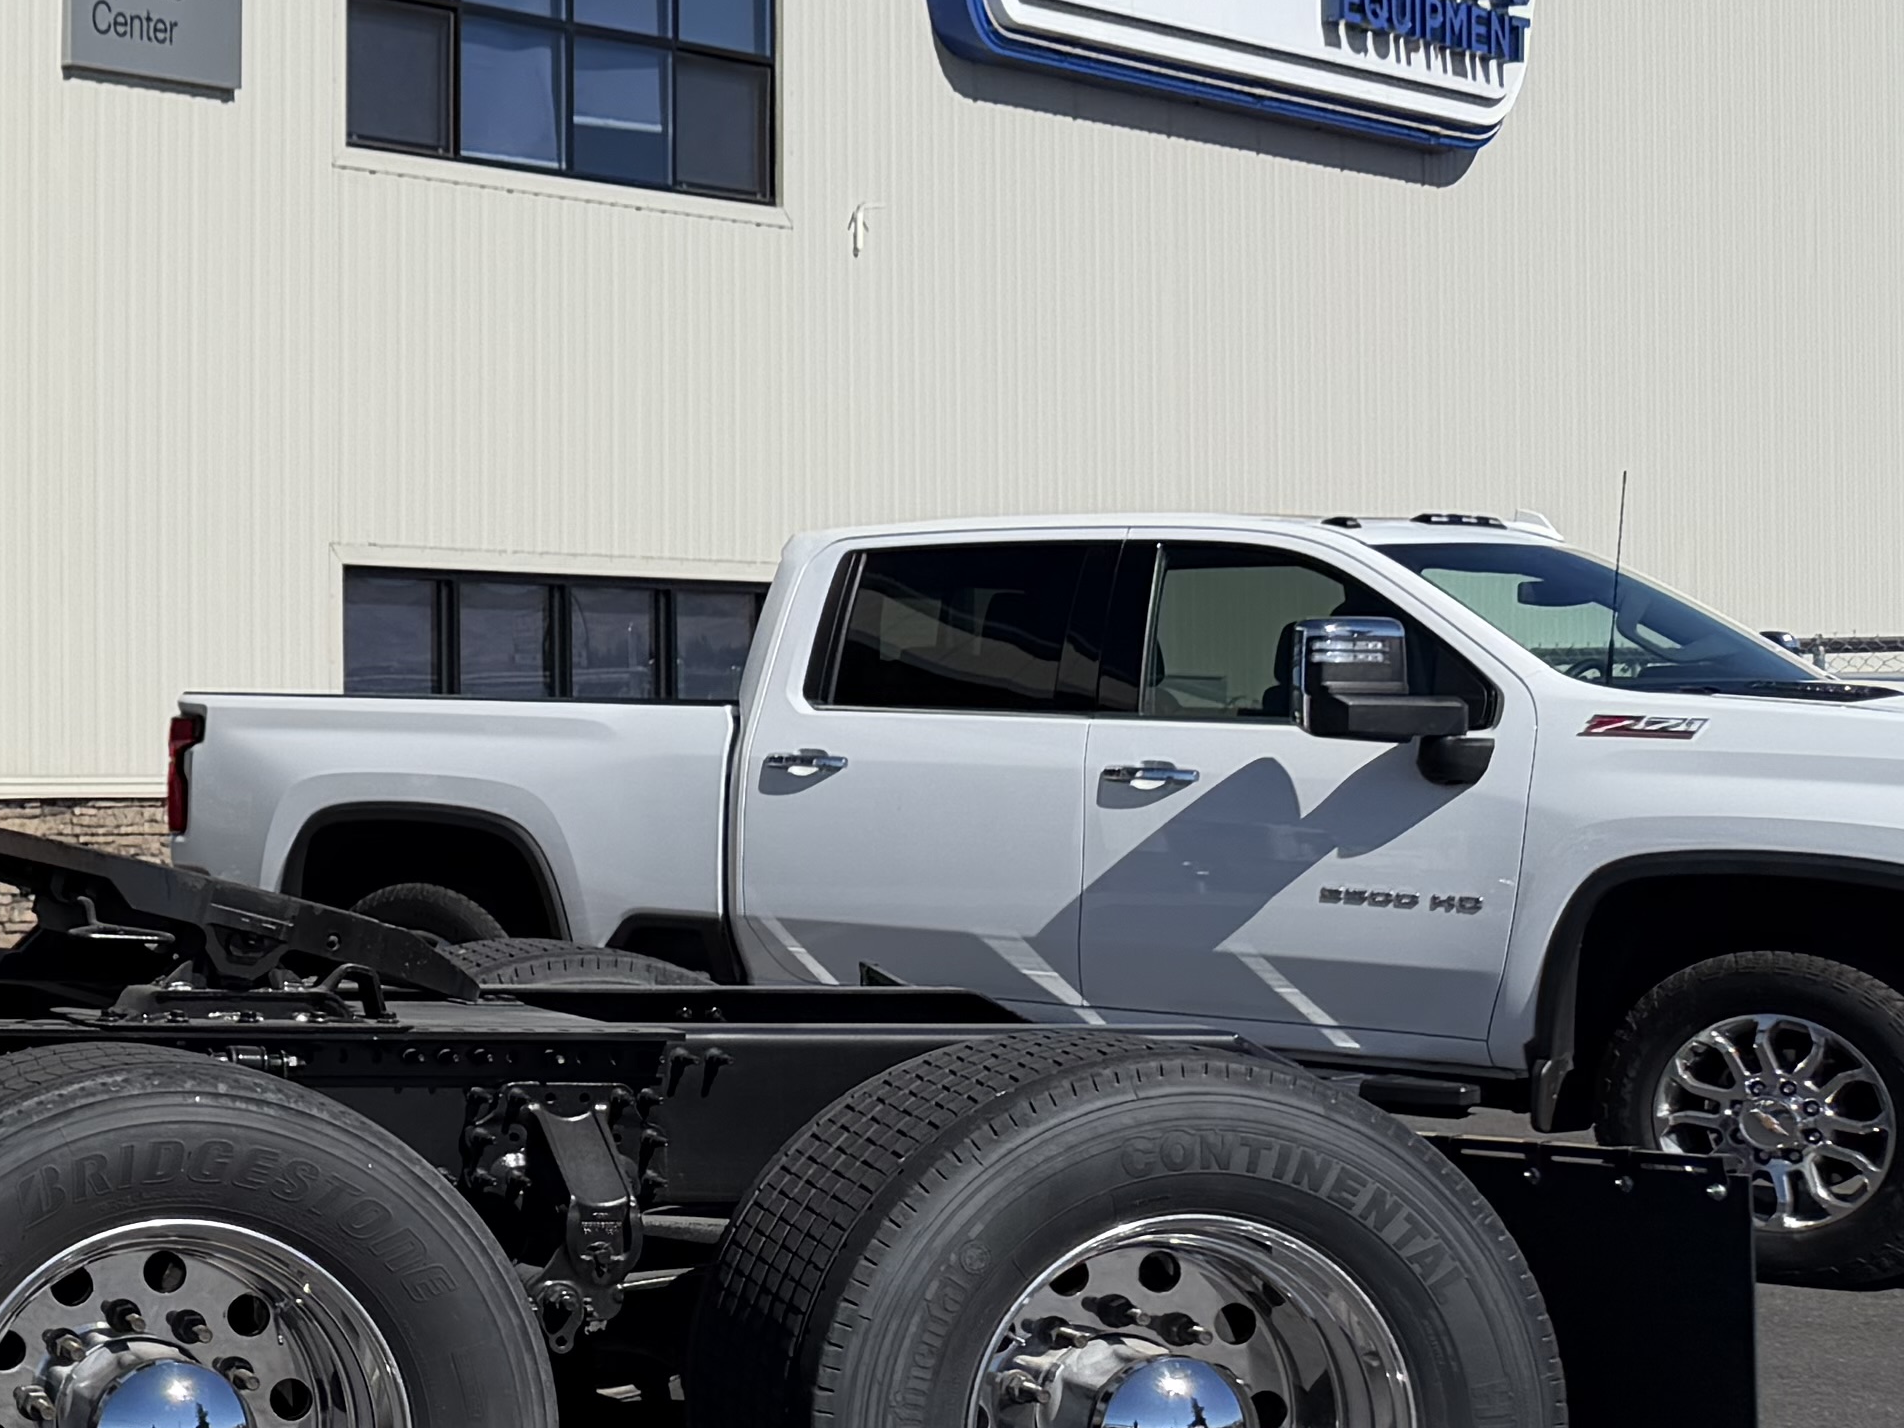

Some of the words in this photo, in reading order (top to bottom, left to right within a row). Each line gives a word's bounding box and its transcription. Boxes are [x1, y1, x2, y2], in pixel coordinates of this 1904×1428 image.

[92, 0, 178, 46] Center
[16, 1138, 458, 1306] BRIDGESTONE
[1119, 1129, 1473, 1305] CONTINENTAL
